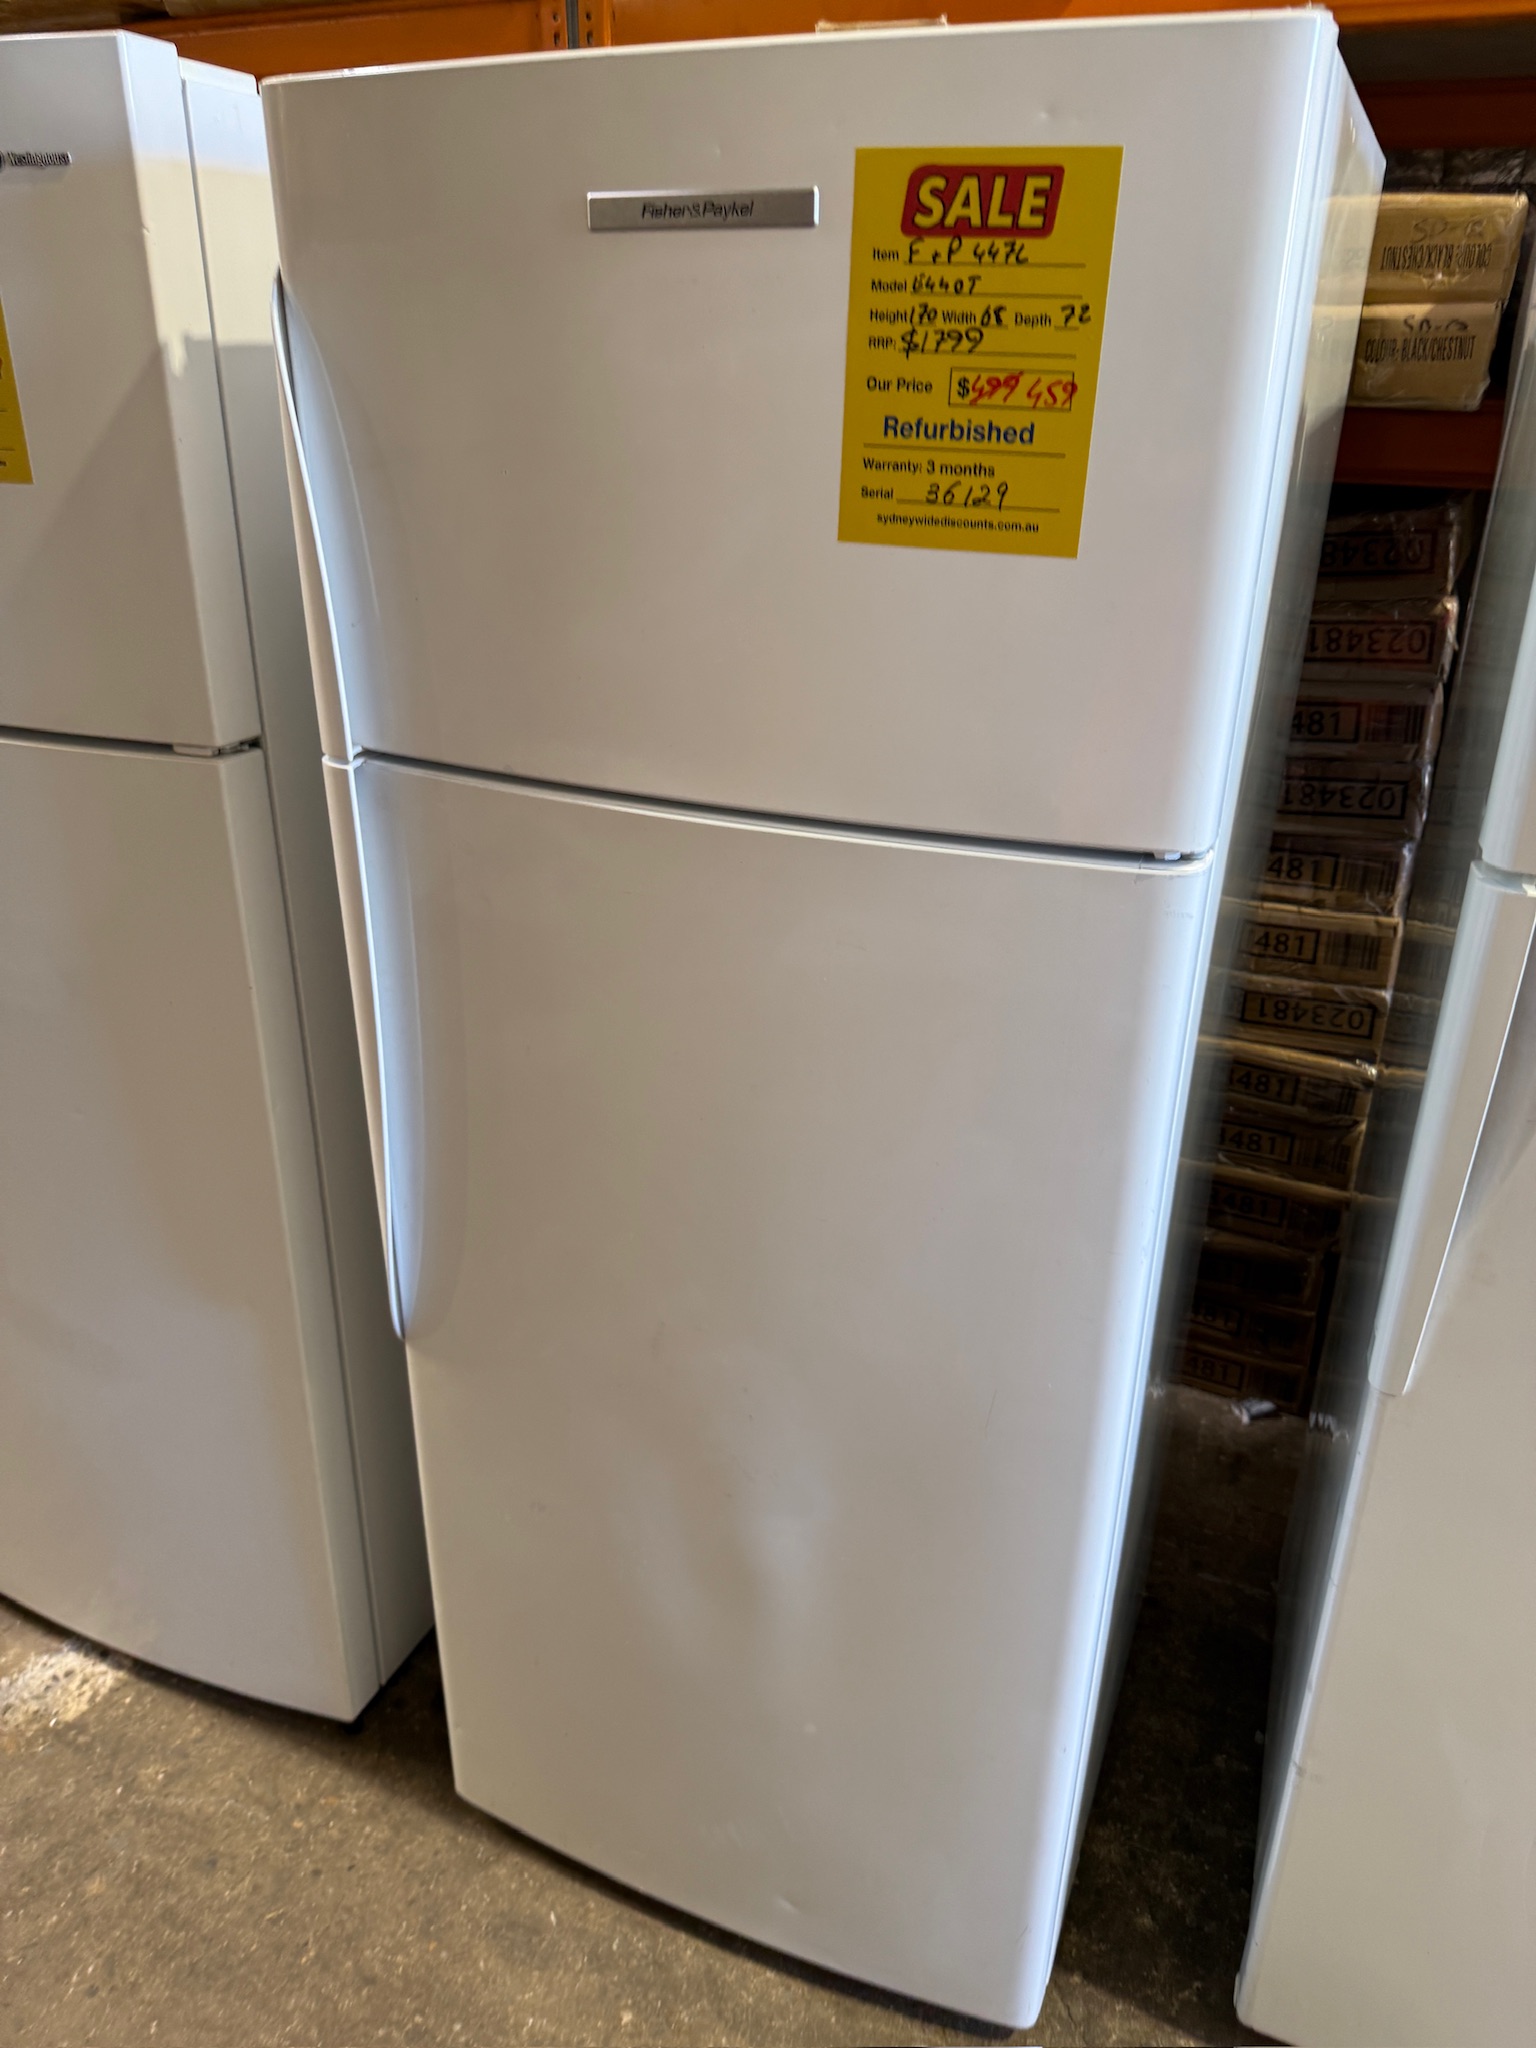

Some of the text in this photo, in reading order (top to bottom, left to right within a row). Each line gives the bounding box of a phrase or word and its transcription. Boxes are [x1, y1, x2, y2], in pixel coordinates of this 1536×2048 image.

[911, 173, 1053, 229] SALE
[873, 247, 899, 262] Item
[946, 234, 963, 264] P
[870, 278, 907, 293] Model
[869, 308, 908, 326] Height
[941, 310, 977, 325] Width
[1014, 312, 1052, 329] Depth
[868, 326, 984, 360] RRP: $1799
[1400, 335, 1477, 363] BLACK/CHESTNUT
[867, 376, 892, 393] Our
[896, 377, 933, 394] Price
[1026, 376, 1079, 410] 459
[883, 415, 1036, 445] Refurbished
[863, 457, 996, 478] Warranty: 3 months
[861, 481, 1009, 512] Serial 36129
[876, 512, 1040, 534] sydneywidediscounts.com.au
[1308, 627, 1427, 655] 023481
[1256, 997, 1365, 1030] 023481
[1230, 1068, 1285, 1098] 481
